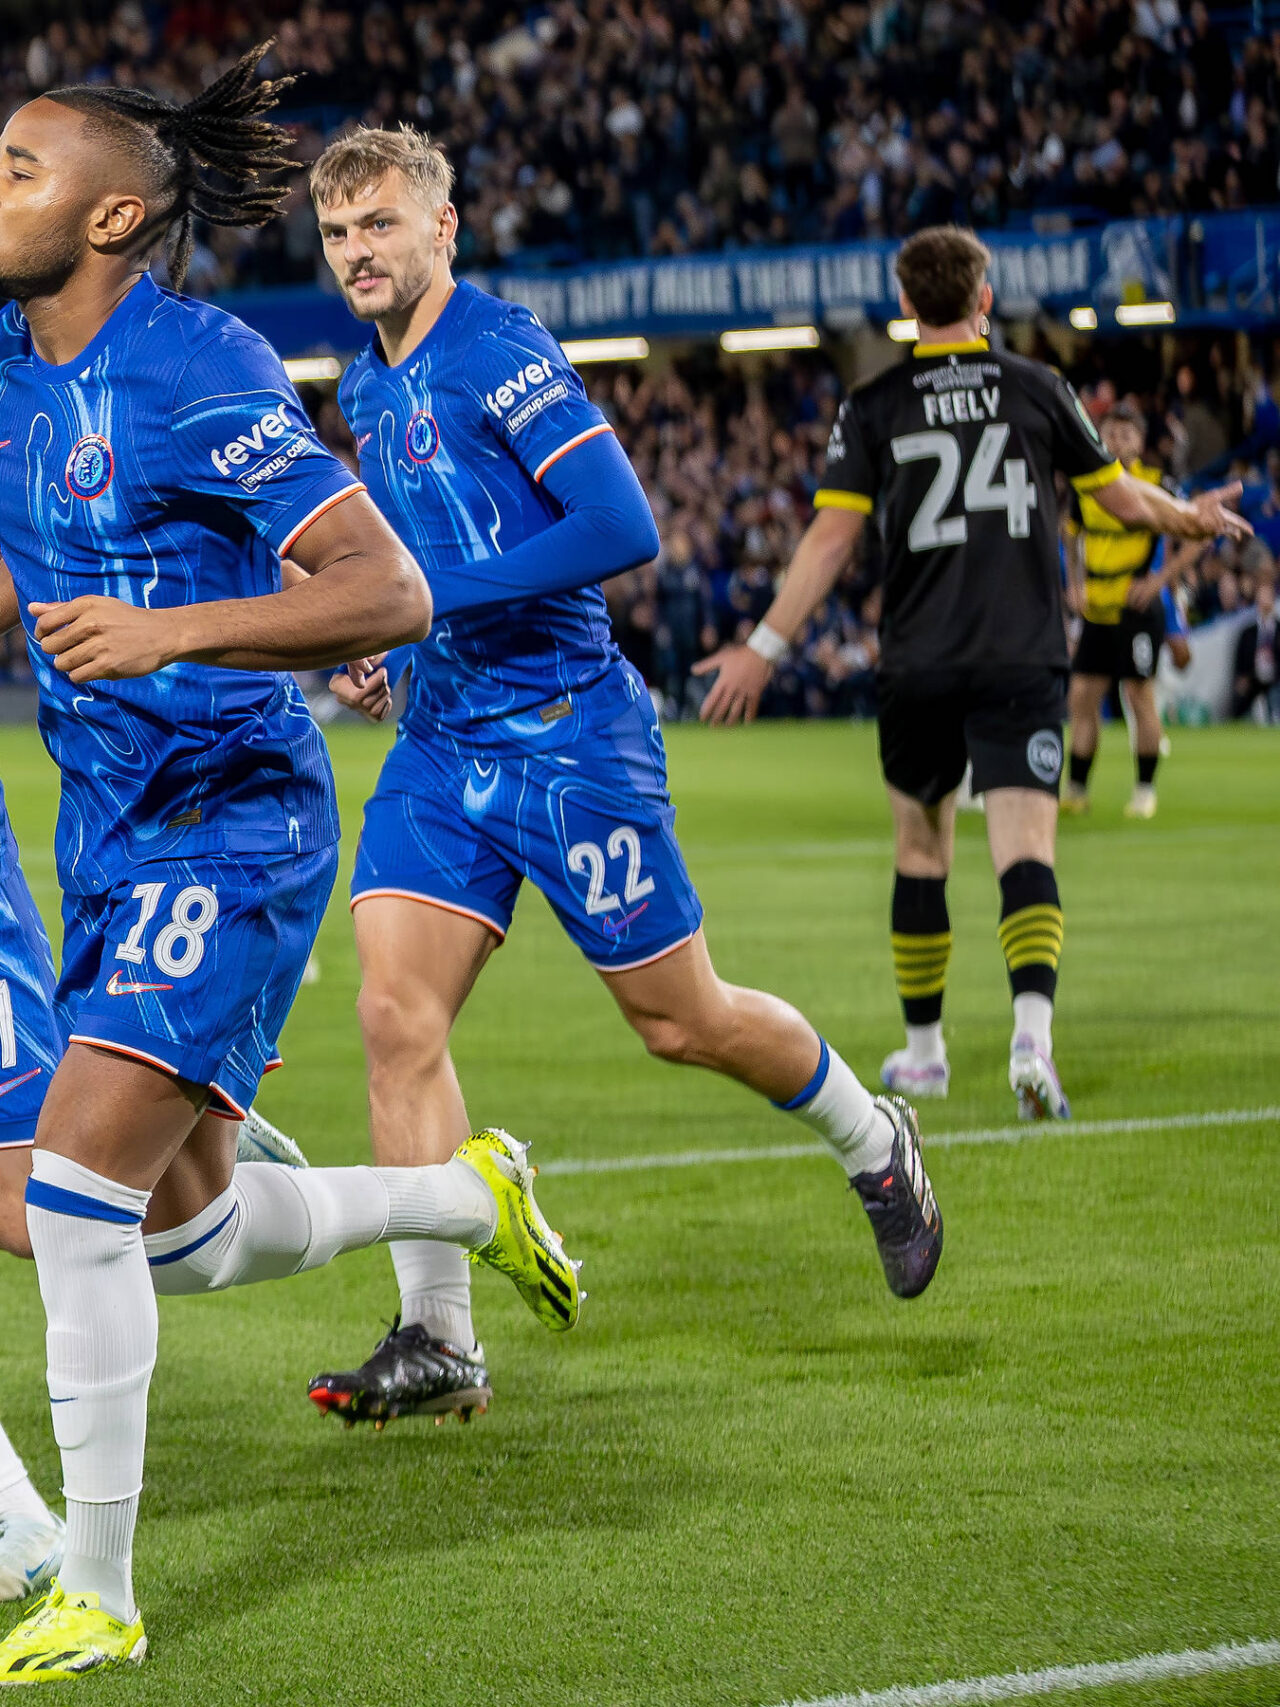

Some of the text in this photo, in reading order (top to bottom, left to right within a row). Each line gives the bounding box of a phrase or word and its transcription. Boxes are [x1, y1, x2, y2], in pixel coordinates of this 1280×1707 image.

[486, 357, 553, 419] fever
[507, 384, 565, 430] feverup.com
[922, 386, 1001, 425] FEELY
[211, 402, 292, 477] fever
[241, 436, 309, 488] feverup.com
[891, 423, 1038, 553] 24
[567, 826, 656, 916] 22
[114, 881, 219, 979] 18
